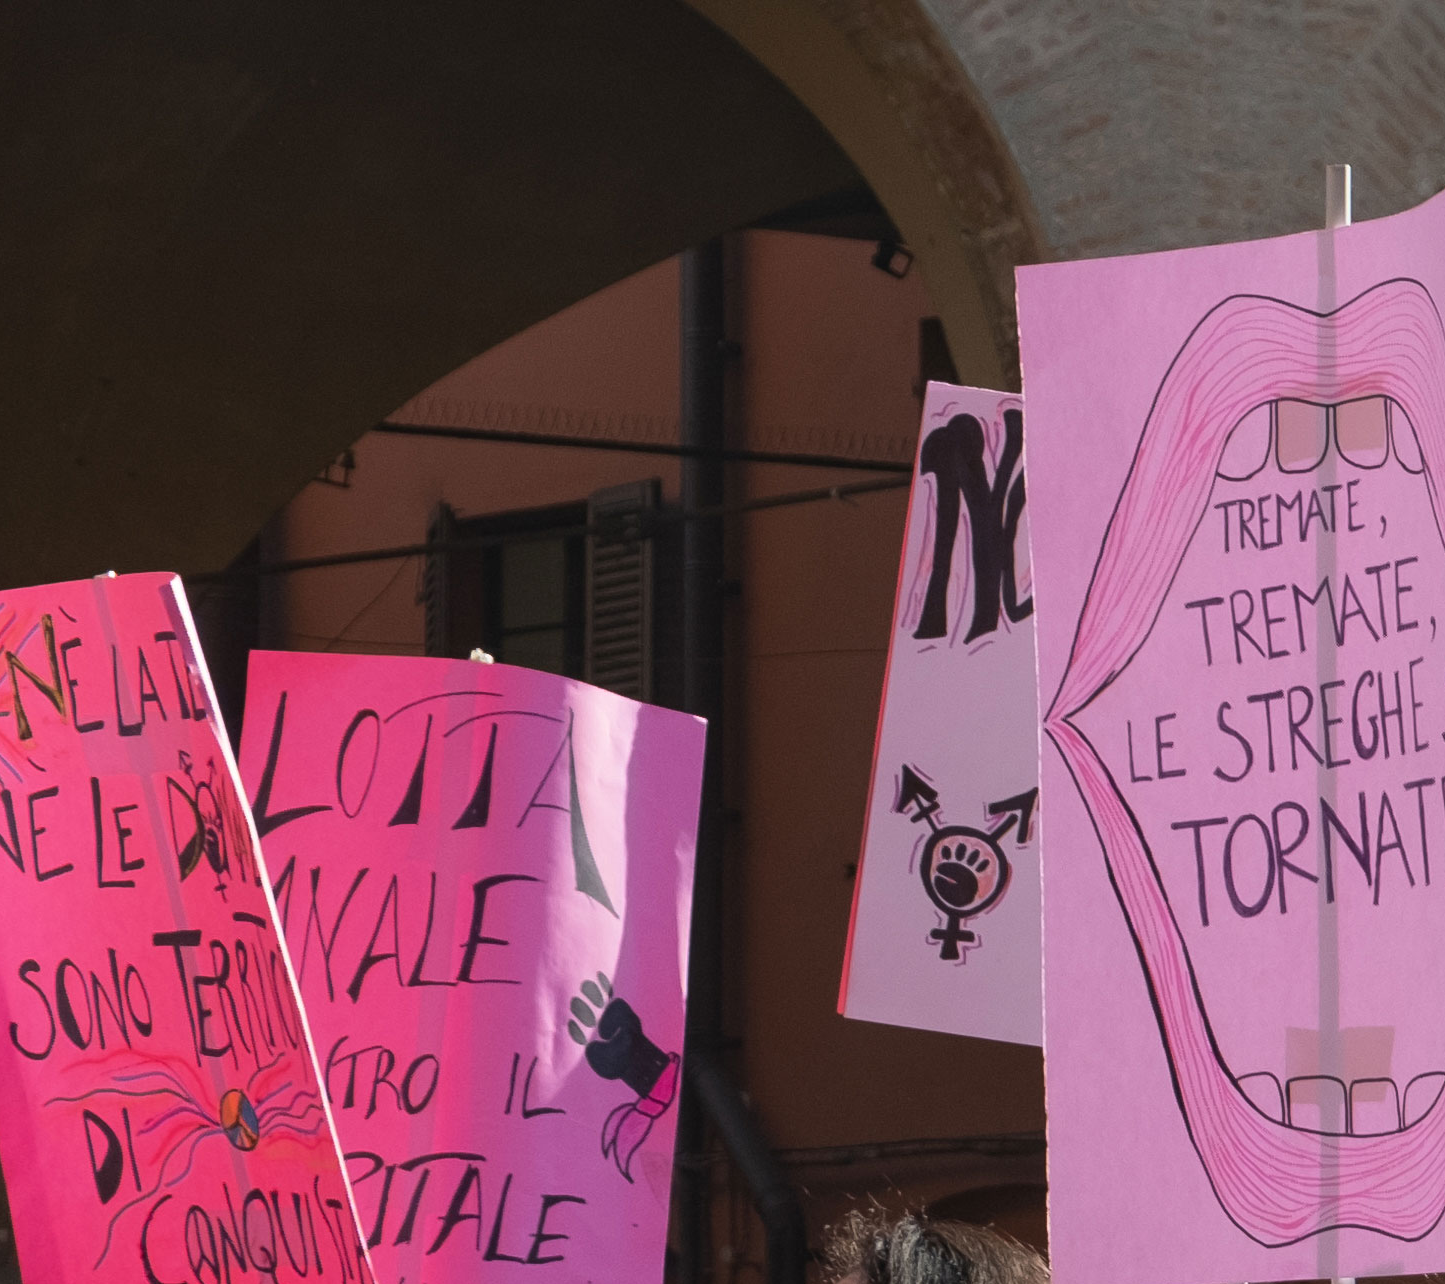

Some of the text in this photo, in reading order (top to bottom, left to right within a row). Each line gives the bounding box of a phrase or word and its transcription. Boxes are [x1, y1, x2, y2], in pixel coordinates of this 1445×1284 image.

[912, 412, 1034, 645] N
[1215, 477, 1388, 554] TREMATE,
[1186, 555, 1438, 668] TREMATE,
[1127, 713, 1188, 784] LE
[1215, 657, 1427, 784] STREGHE
[90, 775, 146, 889] LE
[252, 689, 620, 920] LOTTA
[10, 948, 152, 1062] SONO
[505, 1052, 567, 1120] IL
[83, 1107, 145, 1204] DI
